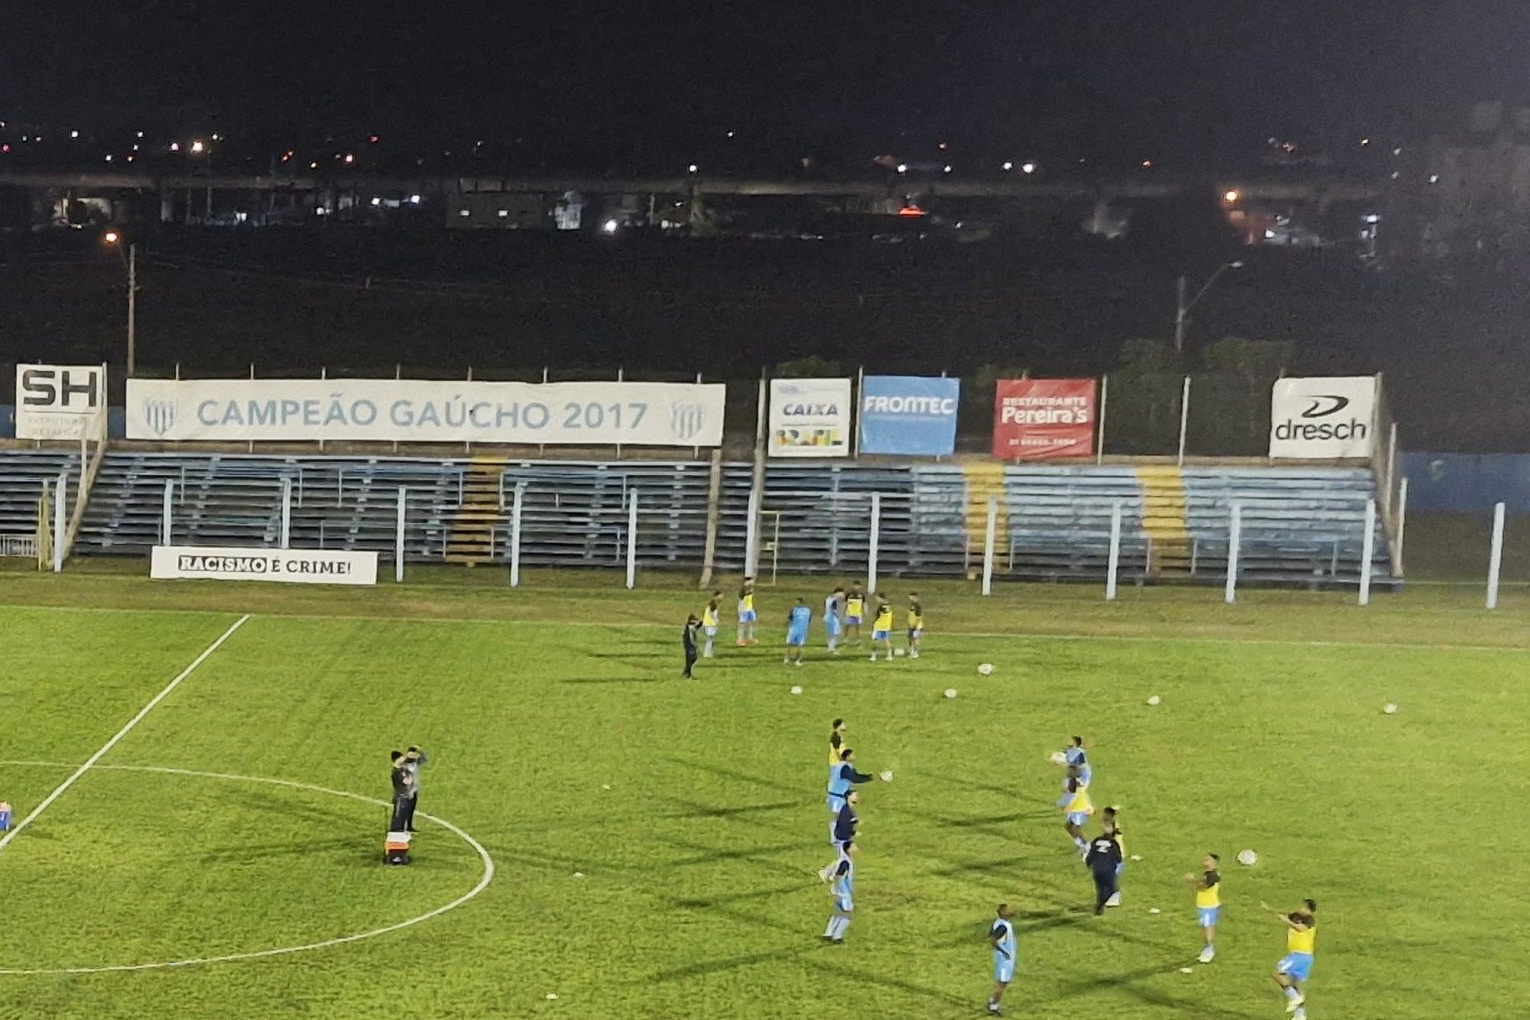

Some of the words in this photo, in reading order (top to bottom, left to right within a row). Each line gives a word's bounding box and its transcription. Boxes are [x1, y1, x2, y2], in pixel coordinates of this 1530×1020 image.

[23, 370, 97, 407] SH
[197, 393, 377, 427] CAMPEÃO
[390, 394, 550, 429] GAÚCHO
[562, 402, 648, 429] 2017
[783, 403, 839, 416] CAIXA
[1001, 406, 1088, 424] Pereira's
[1275, 418, 1366, 440] dresch
[180, 556, 267, 573] RACISMO
[286, 560, 352, 574] CRIME!
